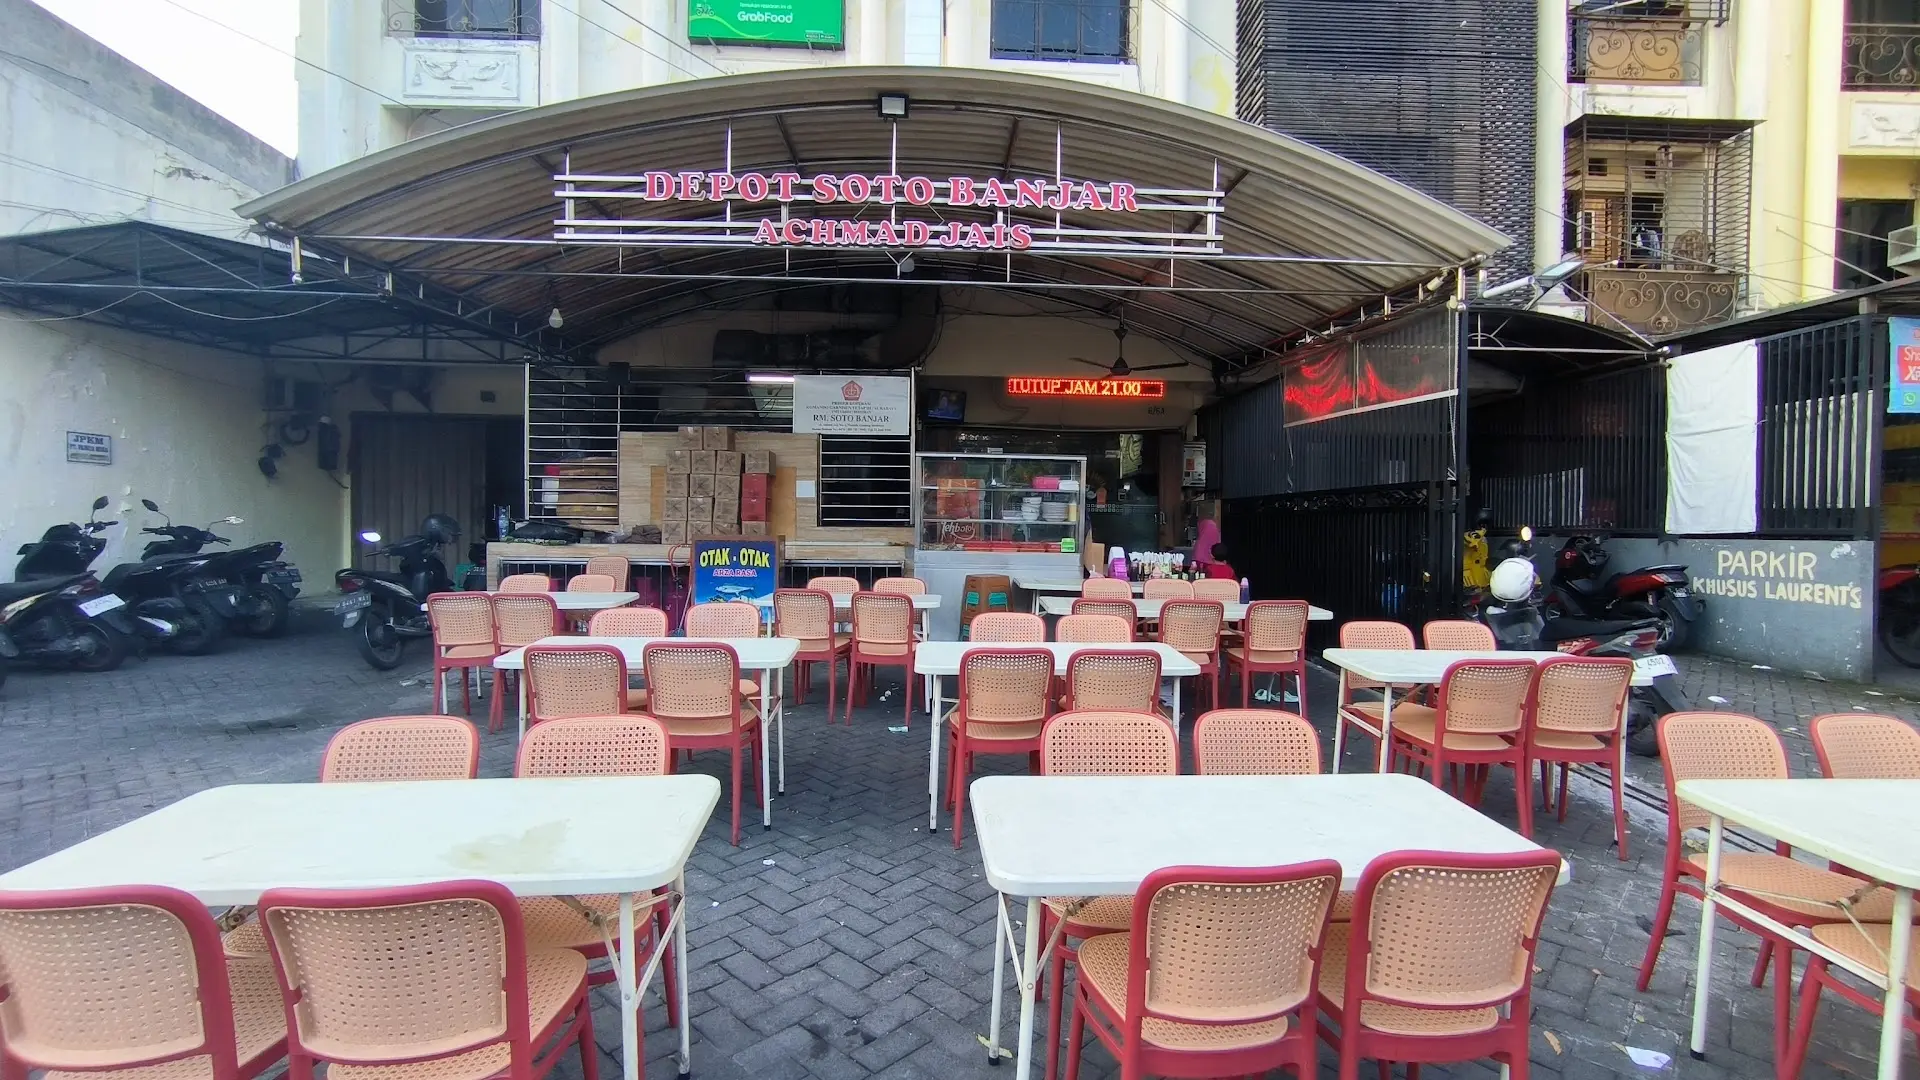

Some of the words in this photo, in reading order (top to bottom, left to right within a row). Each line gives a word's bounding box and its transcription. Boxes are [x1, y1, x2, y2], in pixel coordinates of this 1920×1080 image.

[737, 10, 793, 23] GrabFood
[643, 171, 800, 202] DEPOT
[812, 173, 935, 206] SOTO
[948, 176, 1139, 212] BANJAR
[752, 218, 930, 246] ACHMAD
[939, 221, 1032, 249] JAIS
[1012, 379, 1061, 394] TUTUP
[1065, 380, 1098, 395] JAM
[1101, 381, 1141, 396] 21.00
[830, 414, 854, 422] SOTO
[856, 414, 890, 423] BANJAR
[73, 434, 104, 445] JPKM
[699, 547, 731, 568] OTAK
[739, 547, 770, 568] OTAK
[1717, 546, 1818, 580] PARKIR
[734, 568, 757, 577] RASA
[1692, 576, 1758, 599] KHUSUS
